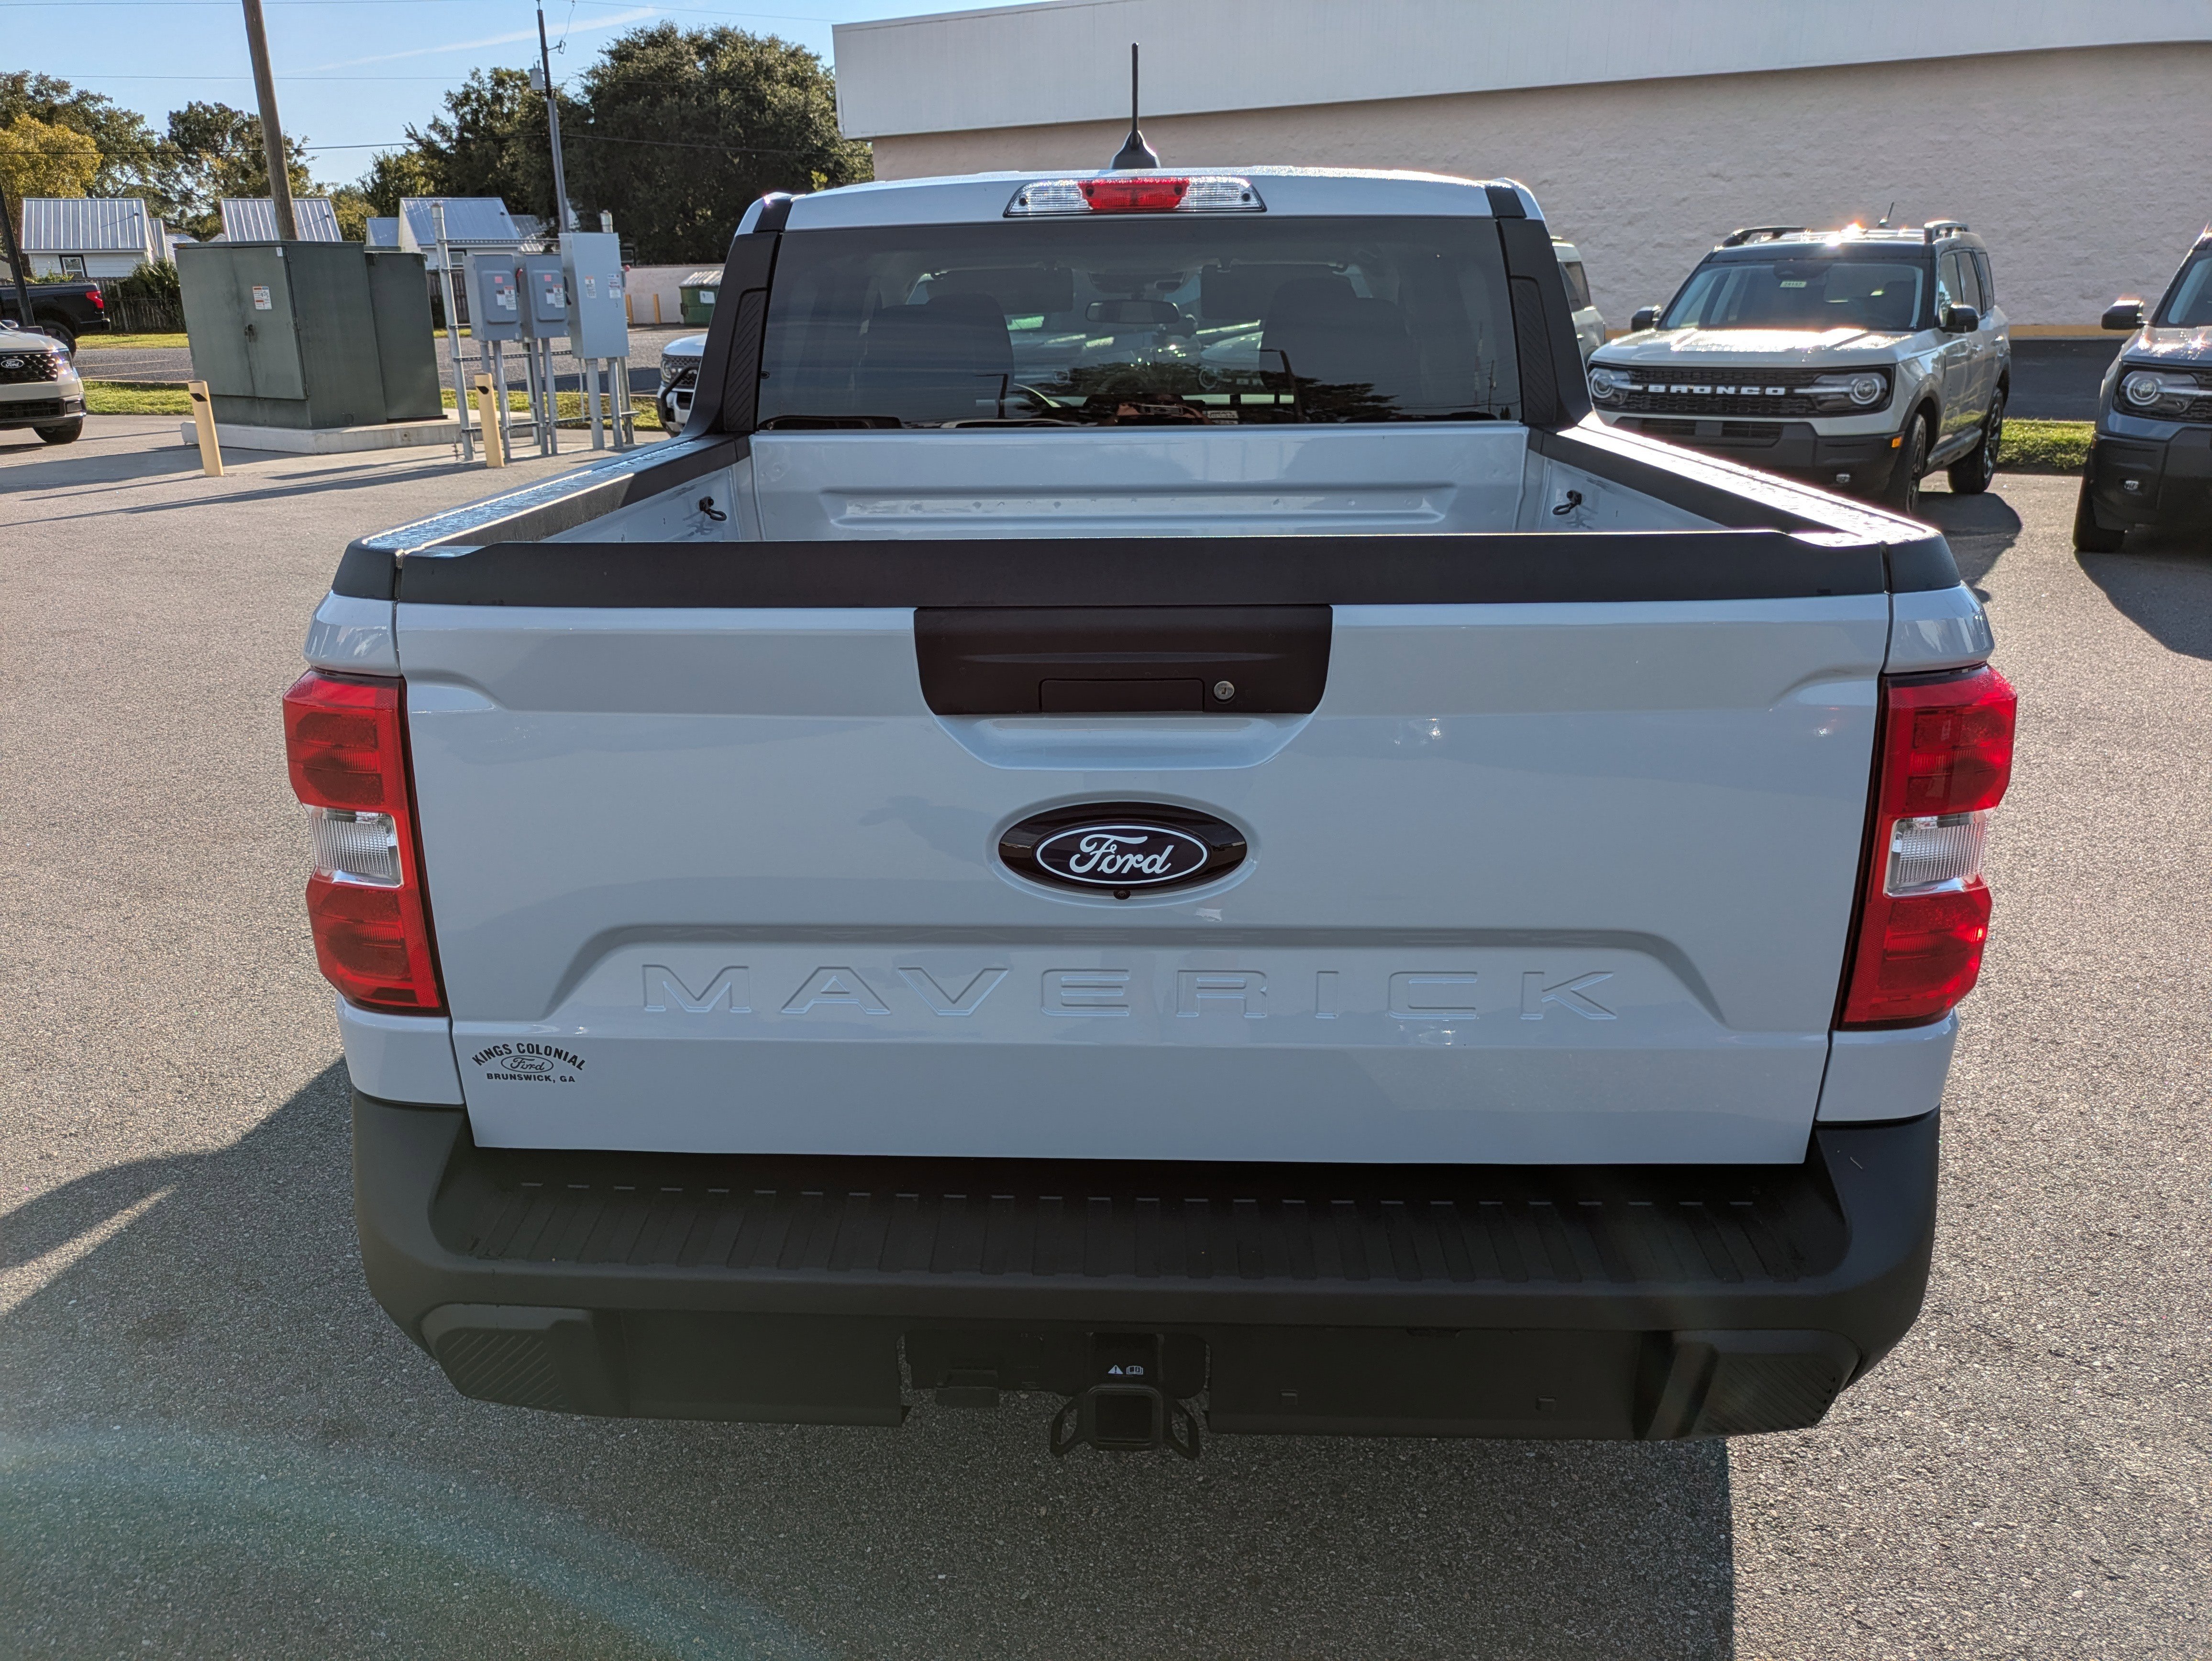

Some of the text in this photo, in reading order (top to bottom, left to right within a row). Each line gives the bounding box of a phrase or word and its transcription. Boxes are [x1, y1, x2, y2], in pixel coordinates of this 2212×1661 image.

[1648, 384, 1786, 396] BRONCO
[1069, 834, 1174, 874] Ford
[641, 964, 1618, 1020] MAVERICK
[472, 1042, 586, 1071] KINGS COLONIAL
[510, 1057, 545, 1071] Ford
[486, 1073, 555, 1084] BRUNSWICK,
